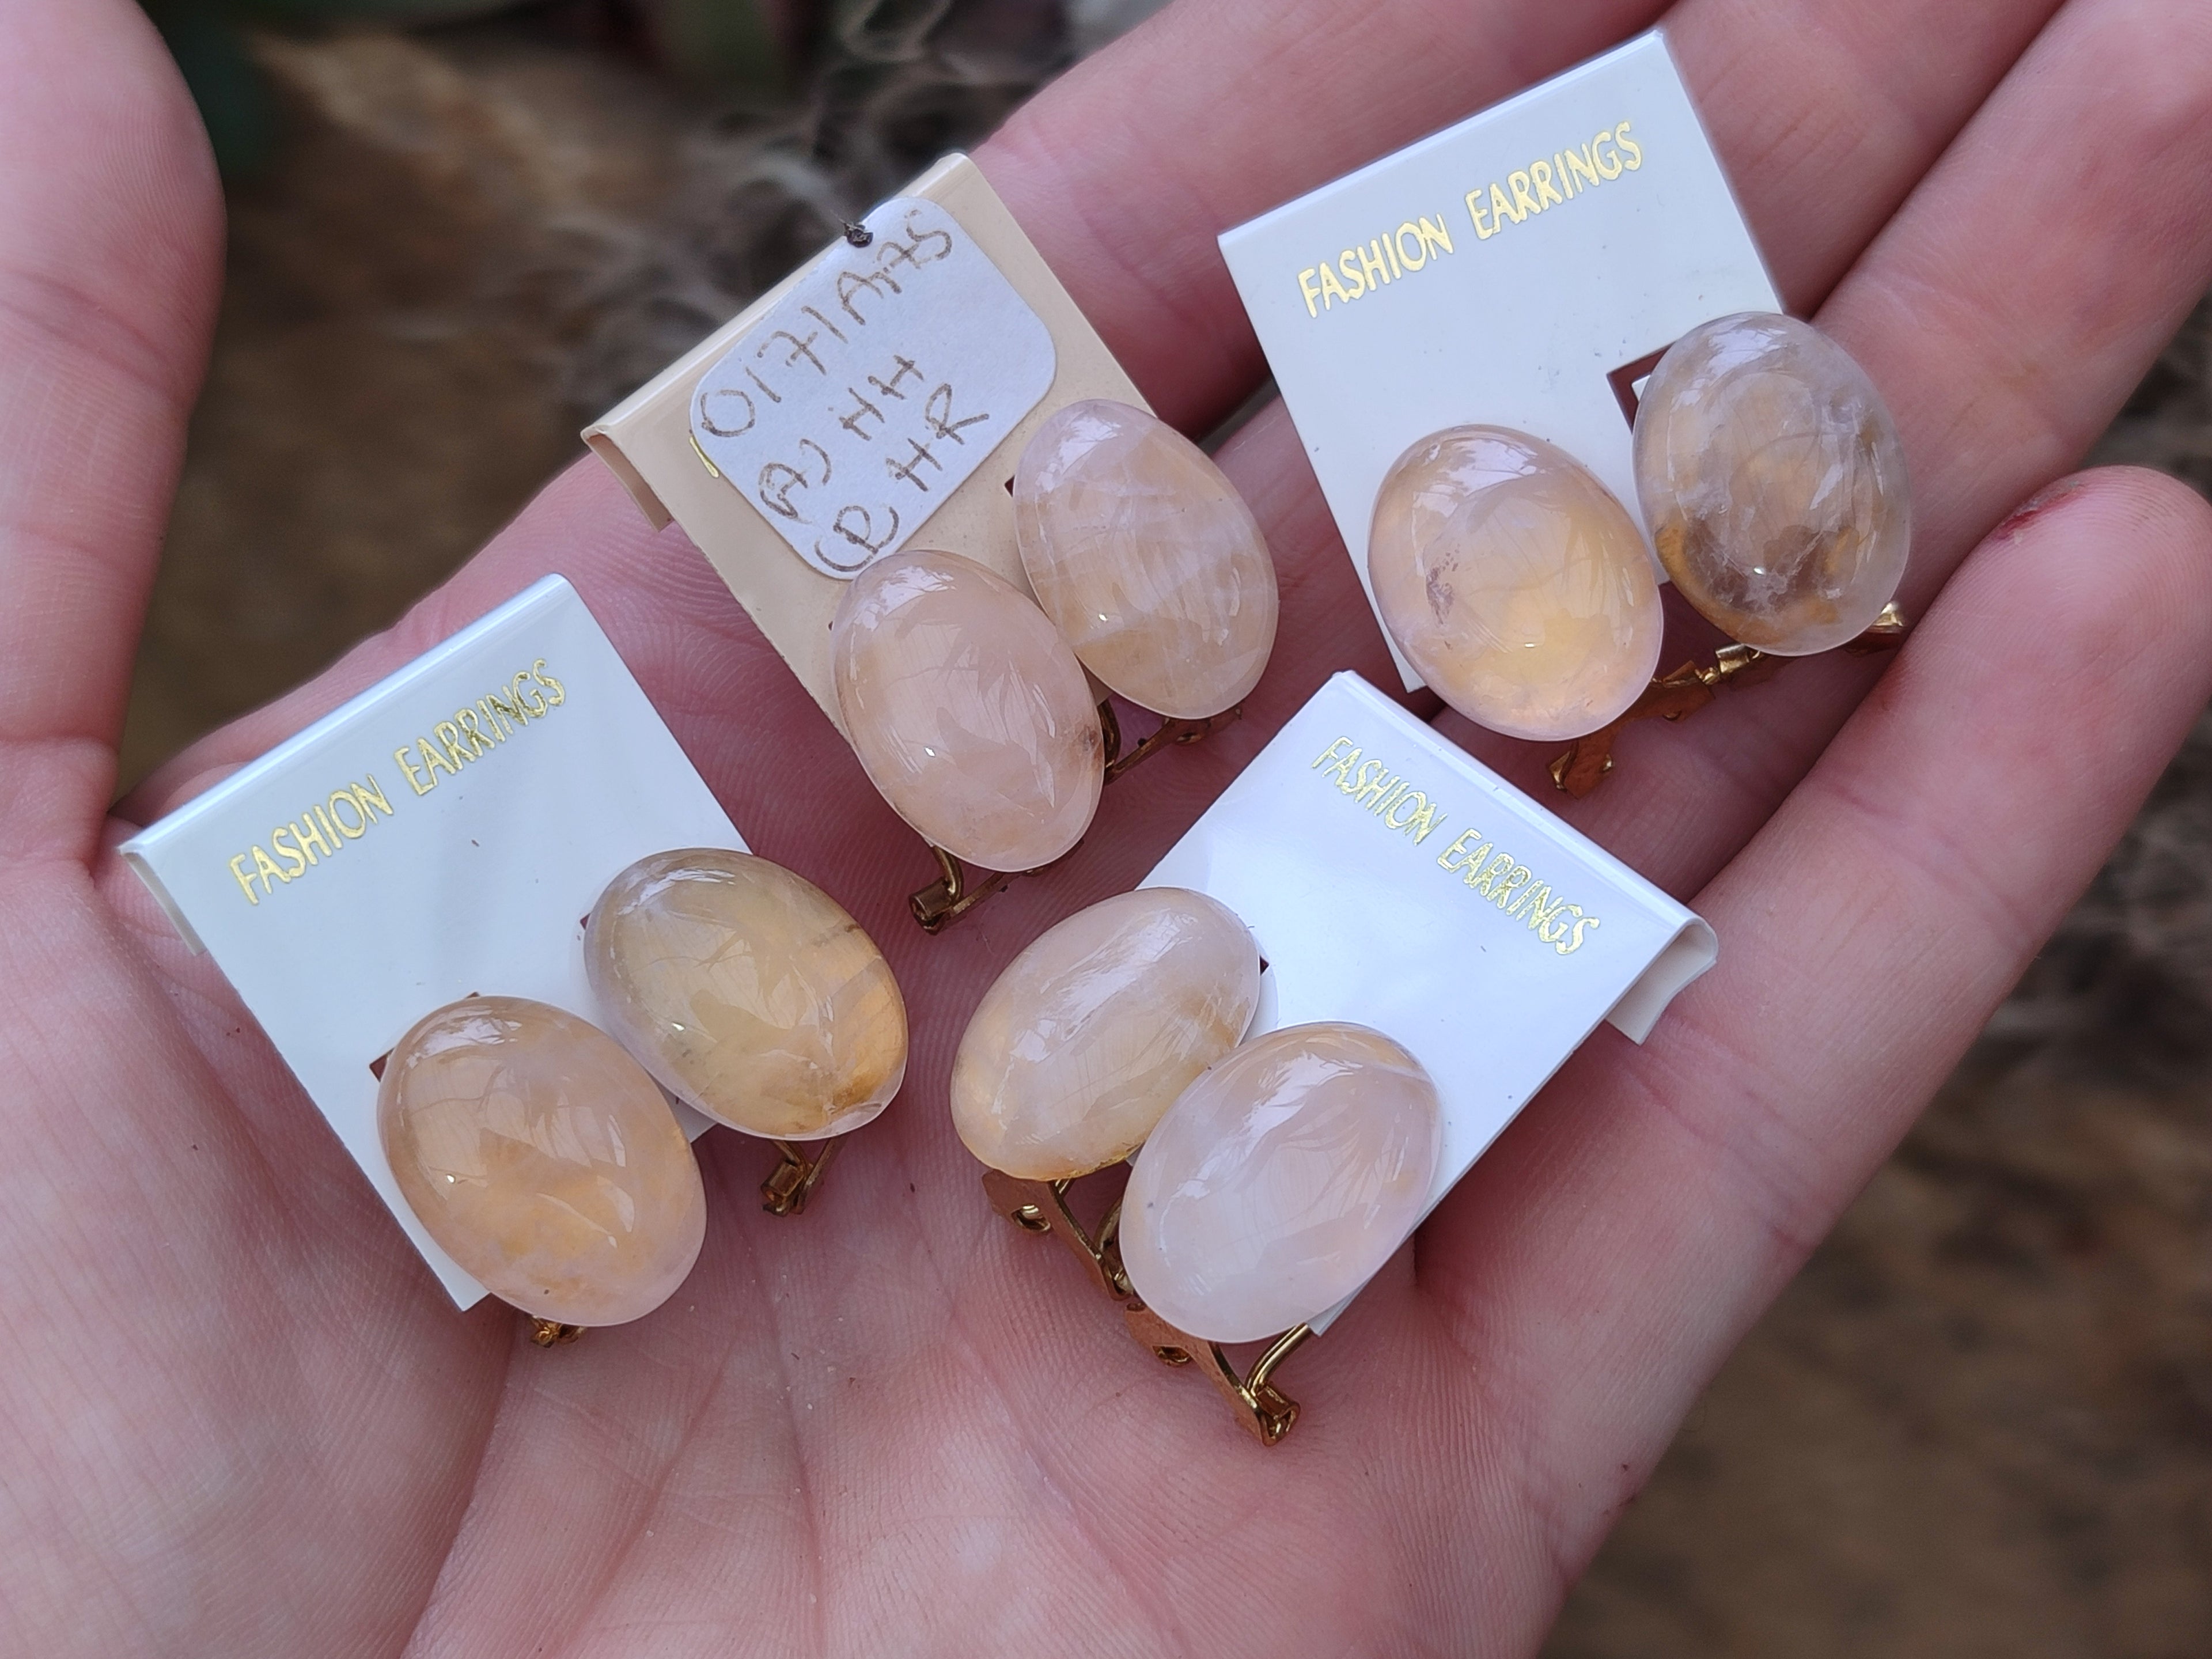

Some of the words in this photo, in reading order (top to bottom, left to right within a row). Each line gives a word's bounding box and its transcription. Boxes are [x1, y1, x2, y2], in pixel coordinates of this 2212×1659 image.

[1297, 213, 1454, 319] FASHION
[1465, 121, 1642, 240] EARRINGS
[229, 774, 394, 905] FASHION
[393, 658, 566, 796] EARRINGS
[1310, 736, 1448, 846] FASHION
[1437, 828, 1601, 955] EARRINGS
